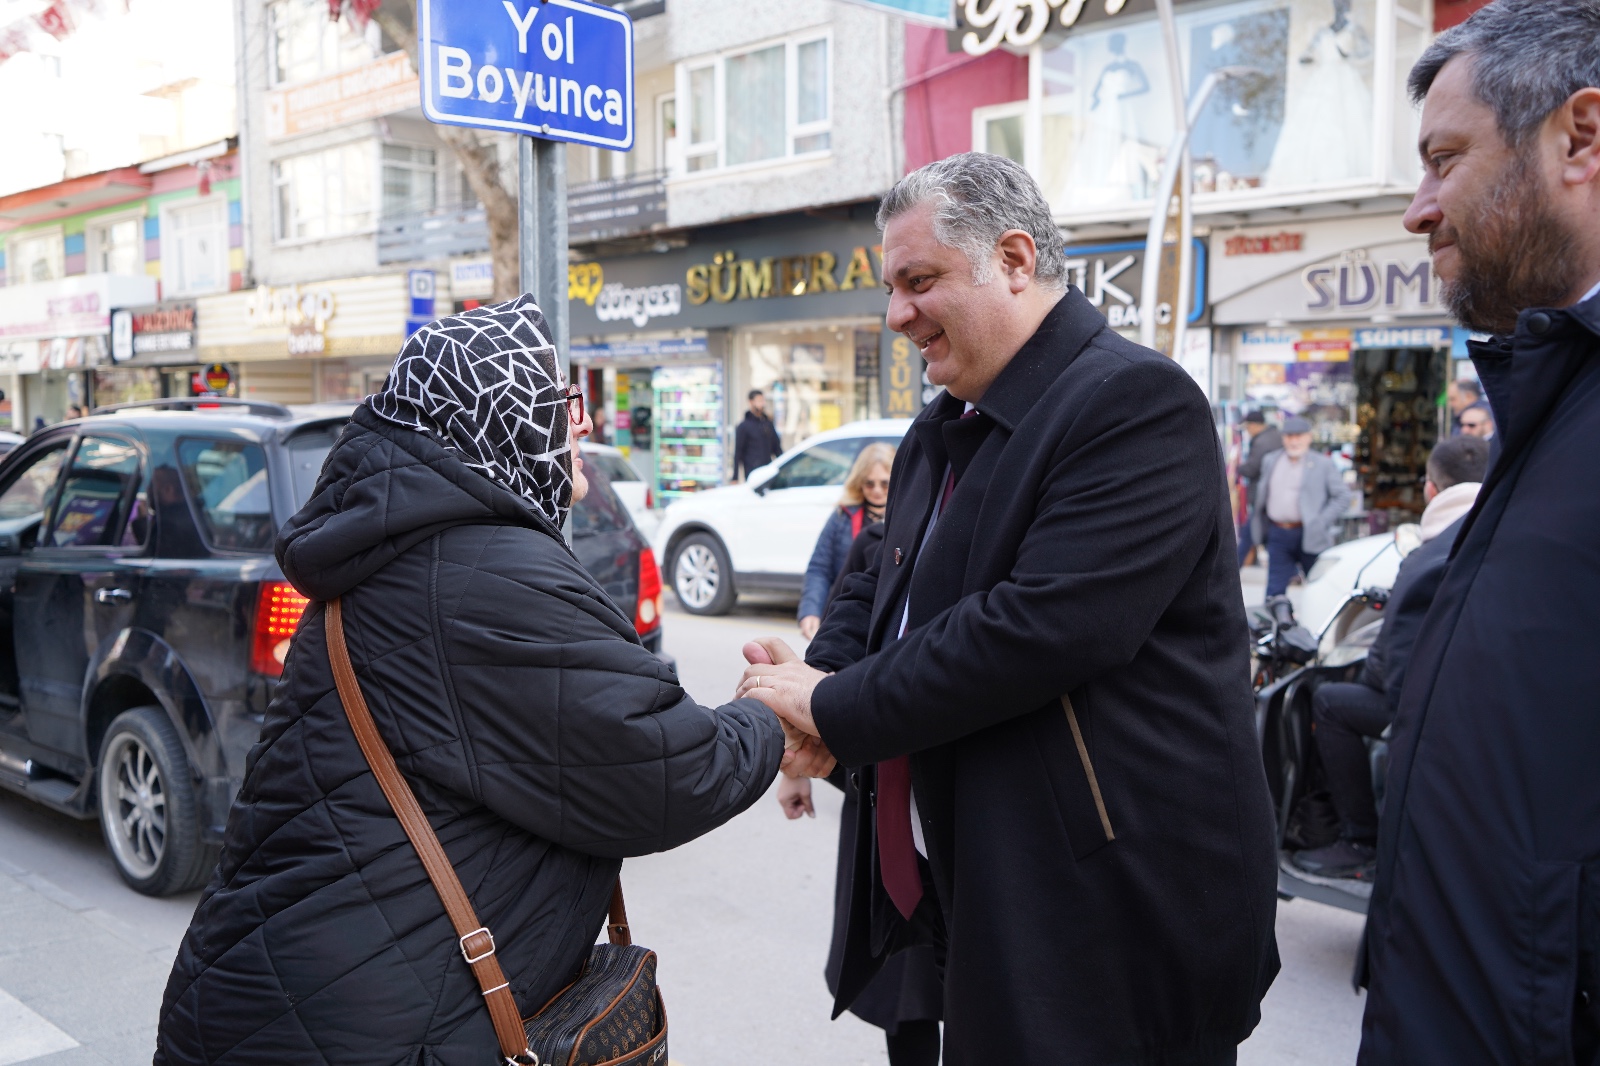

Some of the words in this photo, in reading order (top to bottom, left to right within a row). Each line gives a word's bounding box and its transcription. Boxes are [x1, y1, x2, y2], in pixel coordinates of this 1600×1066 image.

[503, 1, 575, 65] Yol
[438, 45, 624, 127] Boyunca
[1302, 249, 1437, 312] SÜM
[1359, 327, 1443, 347] SÜMER
[886, 336, 915, 418] SÜM
